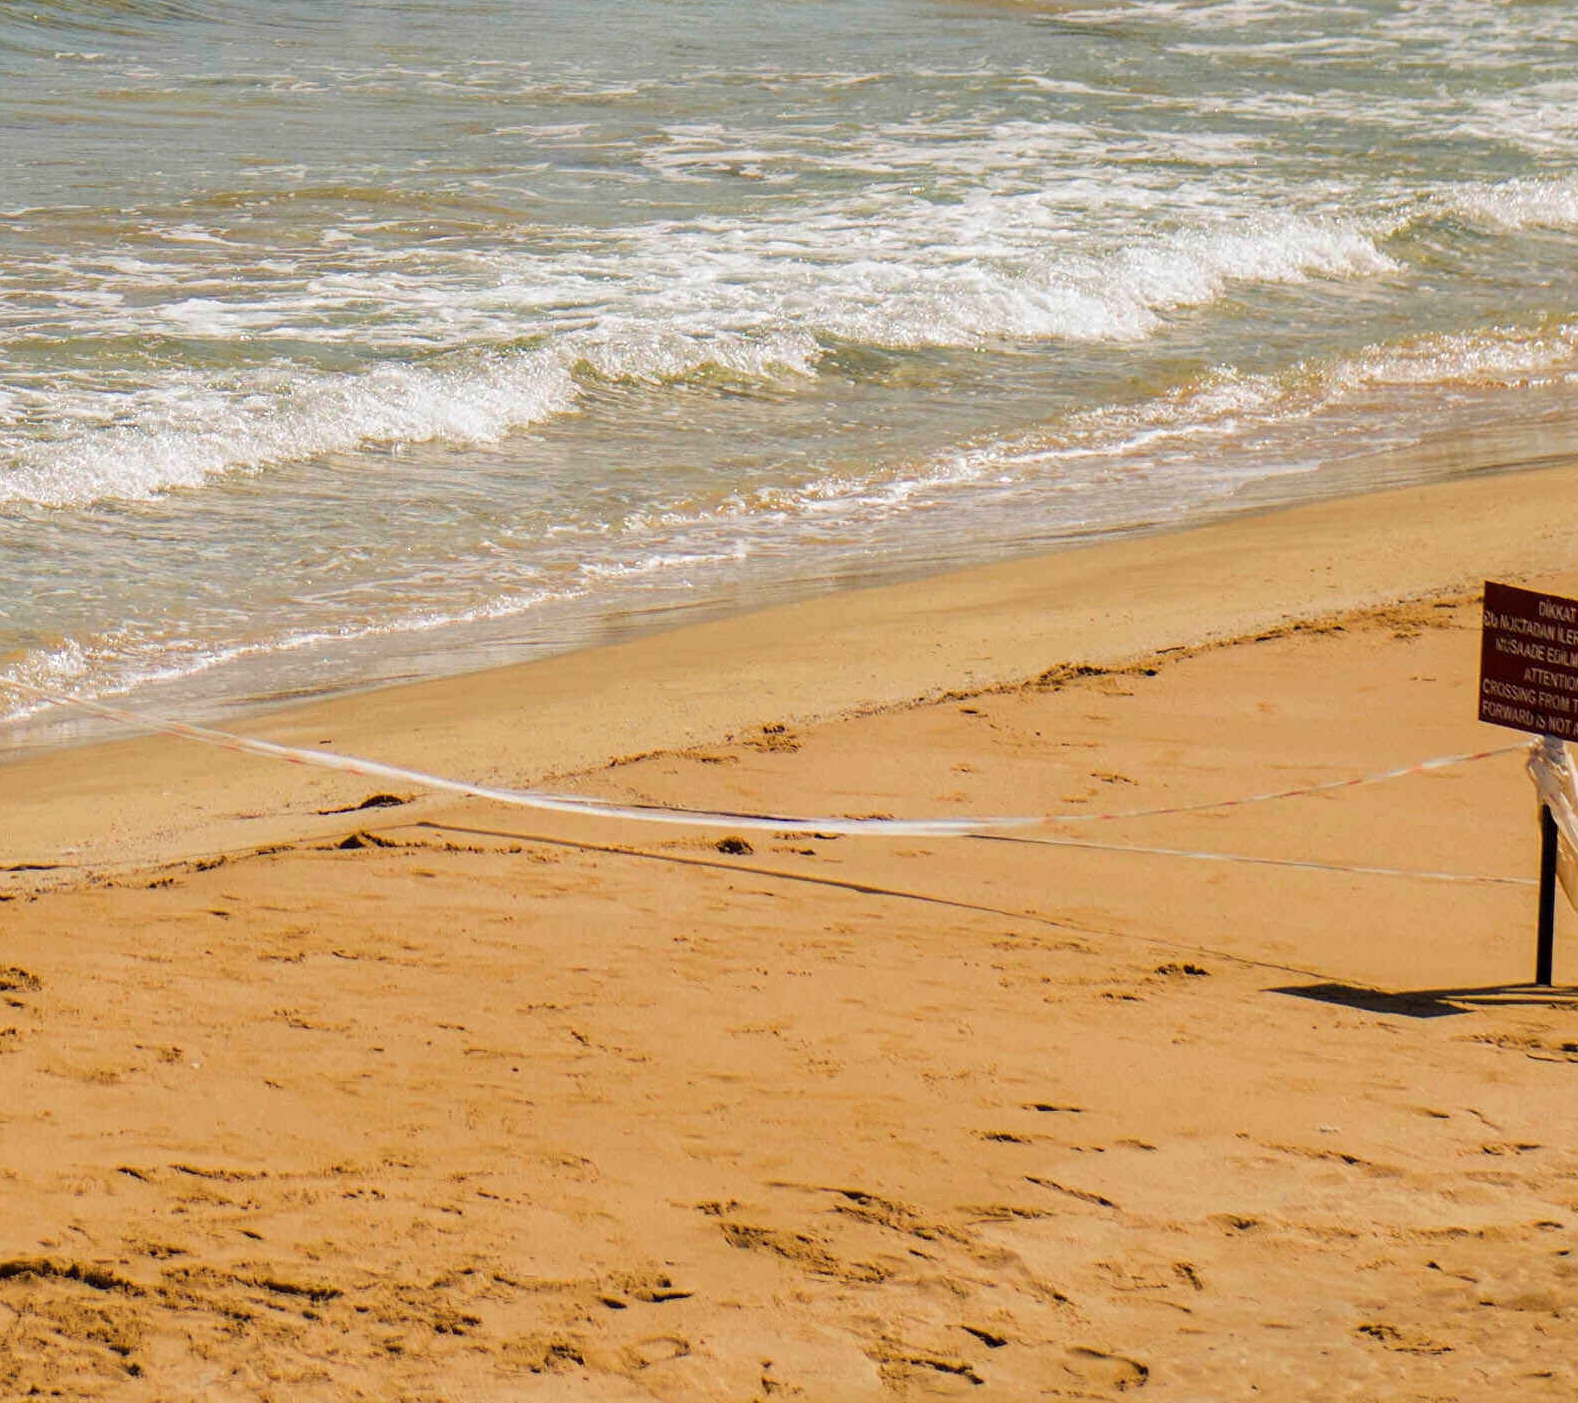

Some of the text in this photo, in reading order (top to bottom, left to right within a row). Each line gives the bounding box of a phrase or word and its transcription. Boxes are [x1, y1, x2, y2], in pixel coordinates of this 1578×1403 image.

[1538, 600, 1576, 623] DİKKAT
[1482, 678, 1536, 704] CROSSING
[1538, 692, 1570, 712] FROM
[1482, 702, 1534, 725] FORWARD
[1536, 714, 1546, 729] IS
[1548, 716, 1572, 734] NOT
